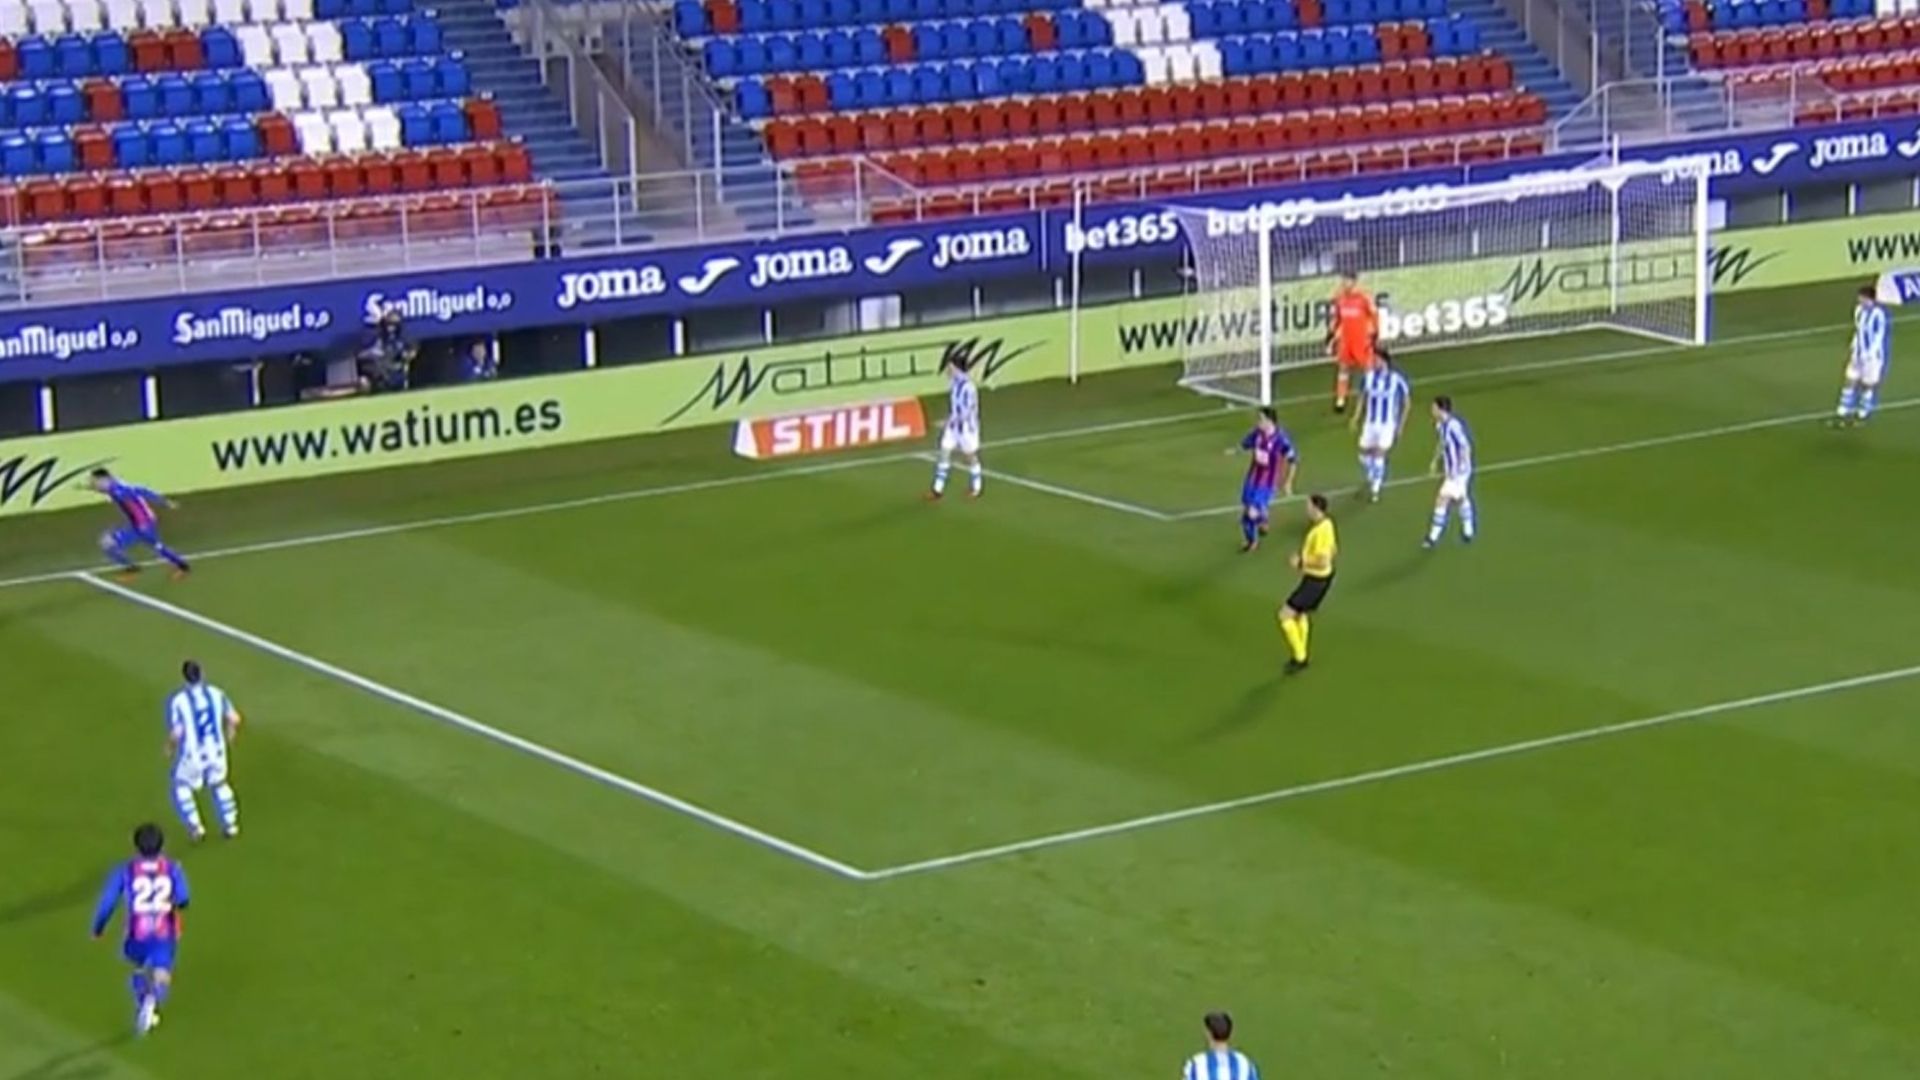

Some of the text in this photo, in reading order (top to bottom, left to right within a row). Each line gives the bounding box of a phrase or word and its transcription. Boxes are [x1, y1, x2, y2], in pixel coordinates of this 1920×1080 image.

[1065, 211, 1178, 252] bet365
[1378, 294, 1507, 339] bet365
[212, 399, 562, 471] www.watium.es
[773, 404, 912, 453] STIHL
[132, 875, 173, 913] 22
